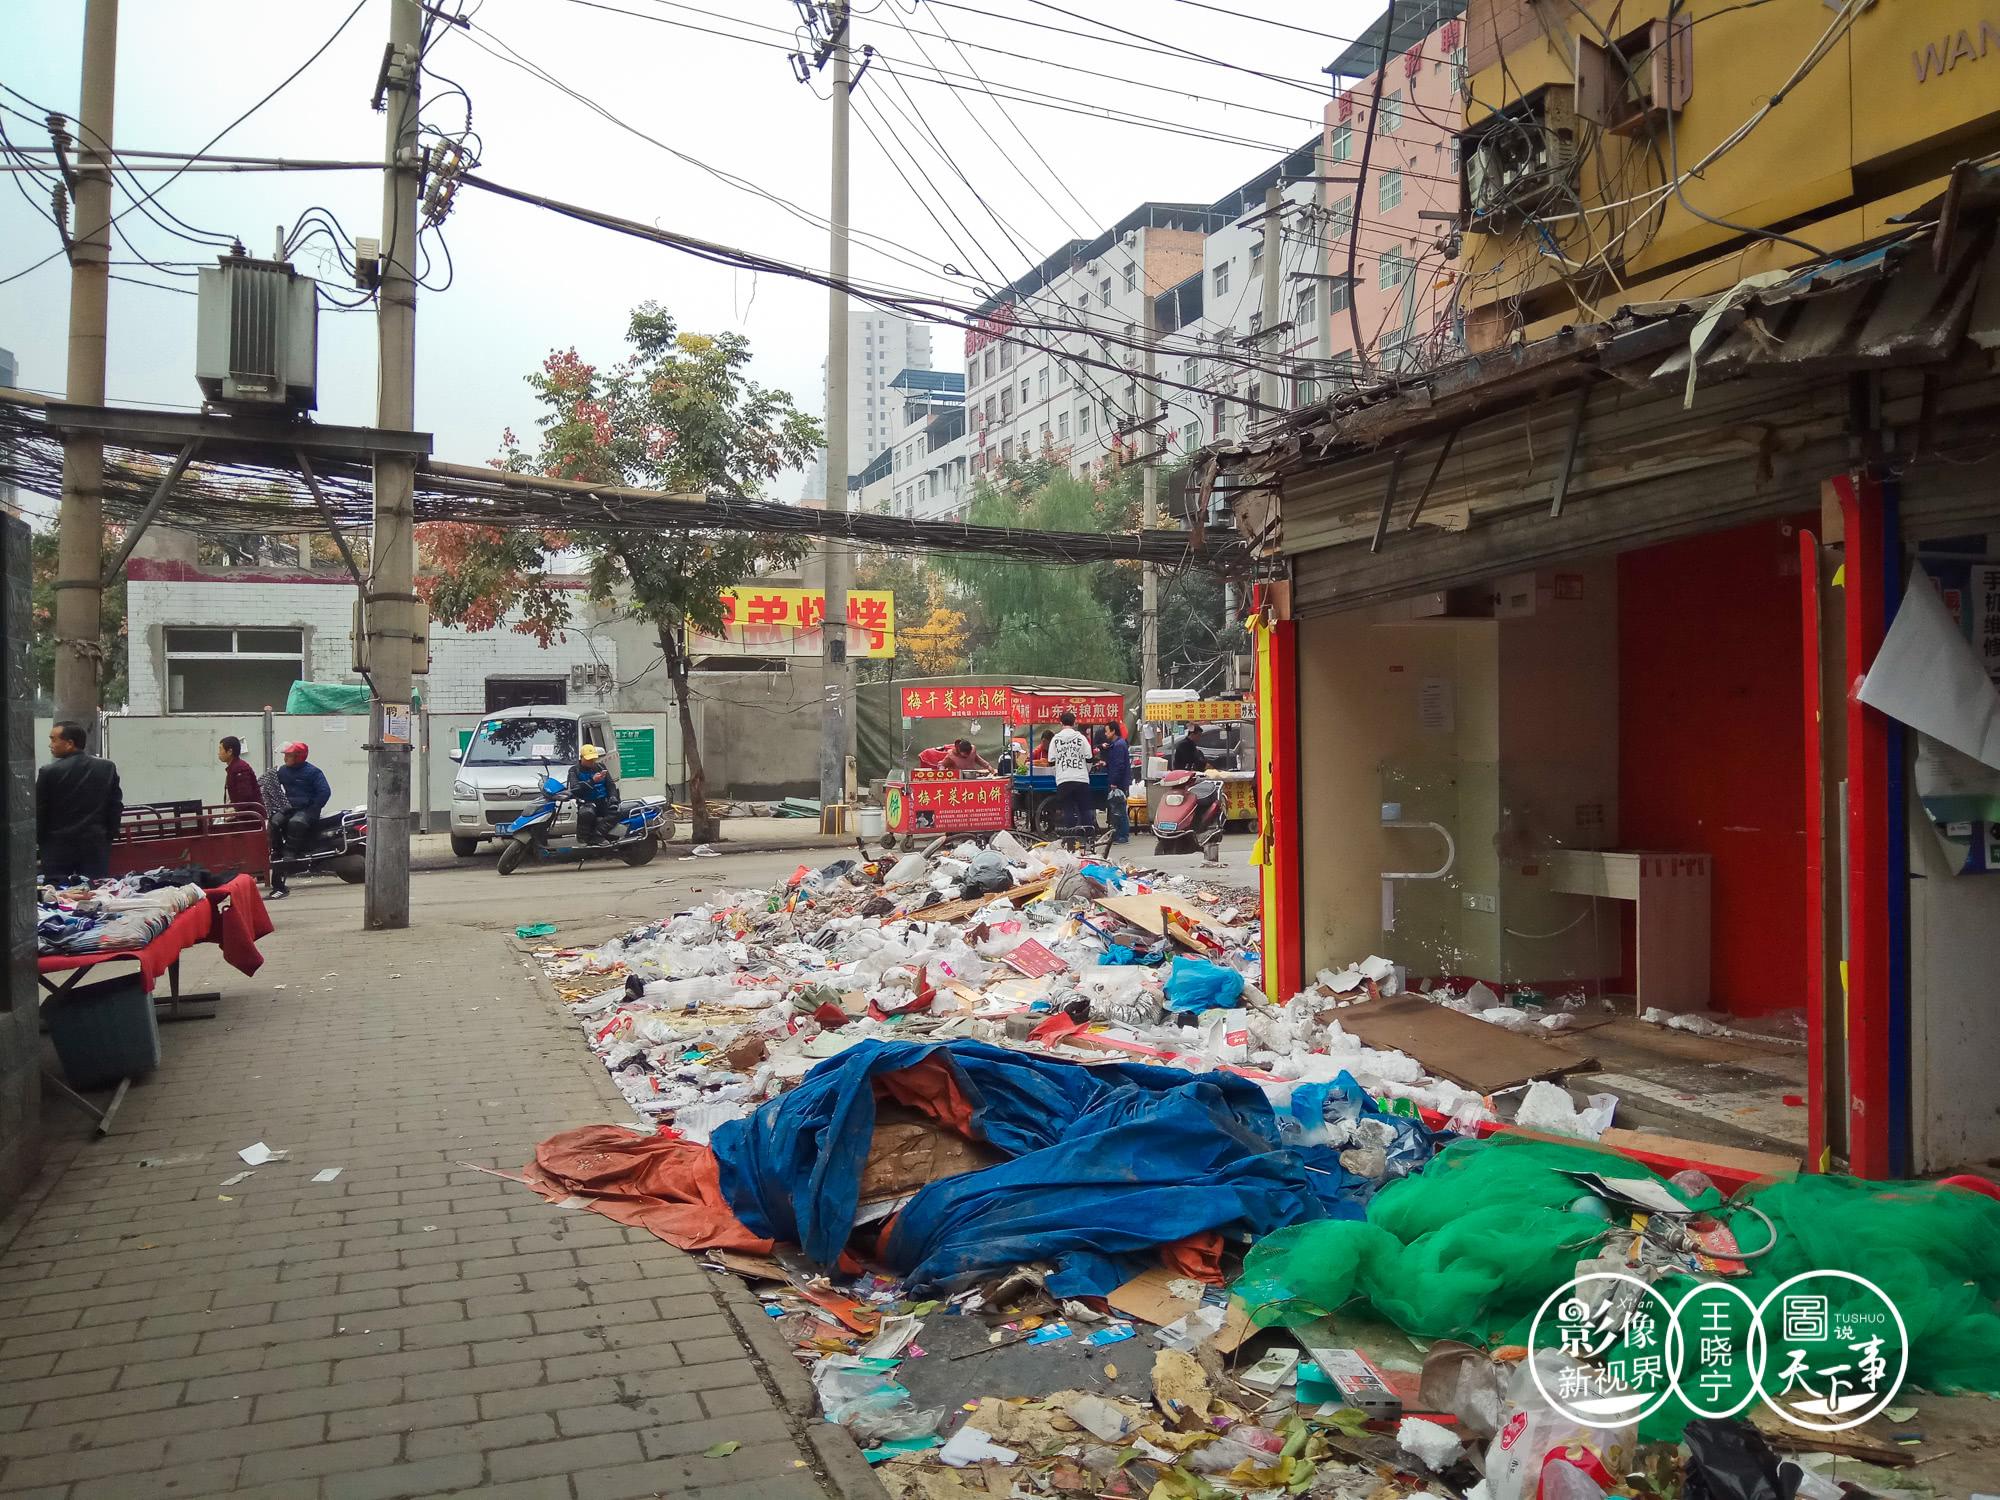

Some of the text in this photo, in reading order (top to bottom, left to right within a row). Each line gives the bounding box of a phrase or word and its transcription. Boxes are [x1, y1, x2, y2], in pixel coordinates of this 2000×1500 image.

[906, 688, 1007, 712] 梅干菜扣肉饼
[1061, 759, 1083, 771] FREE
